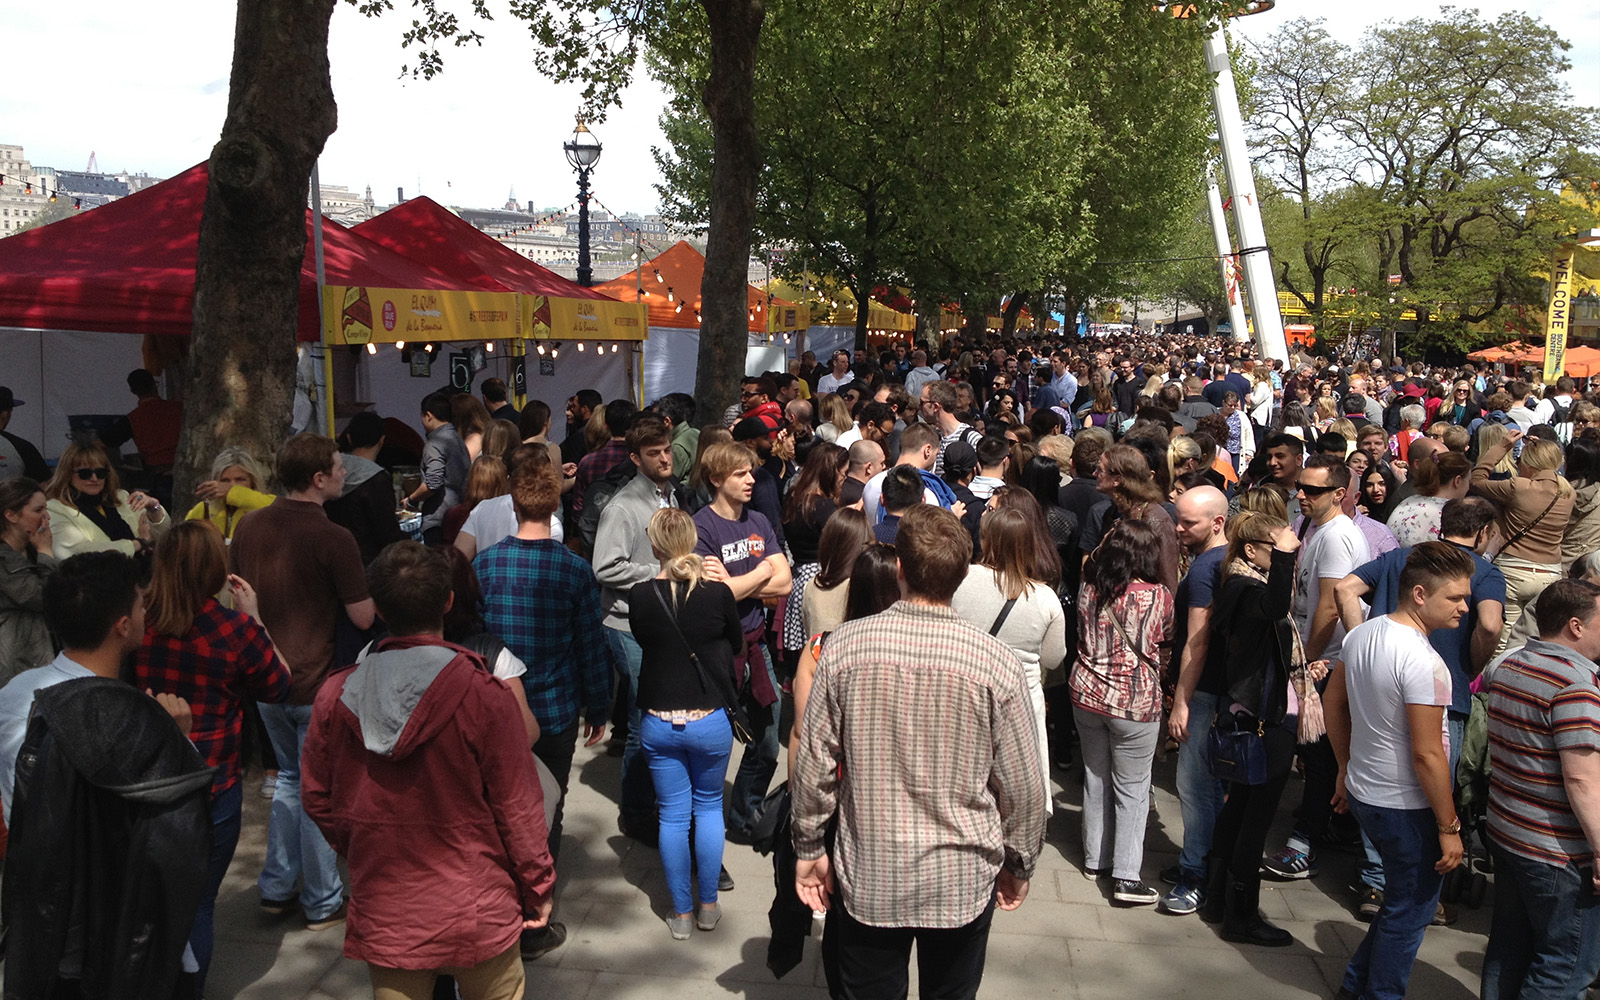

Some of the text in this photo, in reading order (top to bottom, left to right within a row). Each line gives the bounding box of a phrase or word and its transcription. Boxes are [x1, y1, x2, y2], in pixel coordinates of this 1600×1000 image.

[411, 294, 419, 310] EL
[1551, 258, 1569, 329] WELCOME
[1549, 333, 1557, 356] CENTRE
[1554, 333, 1564, 371] SOUTHBANK
[452, 356, 469, 389] 5
[515, 363, 524, 384] 6
